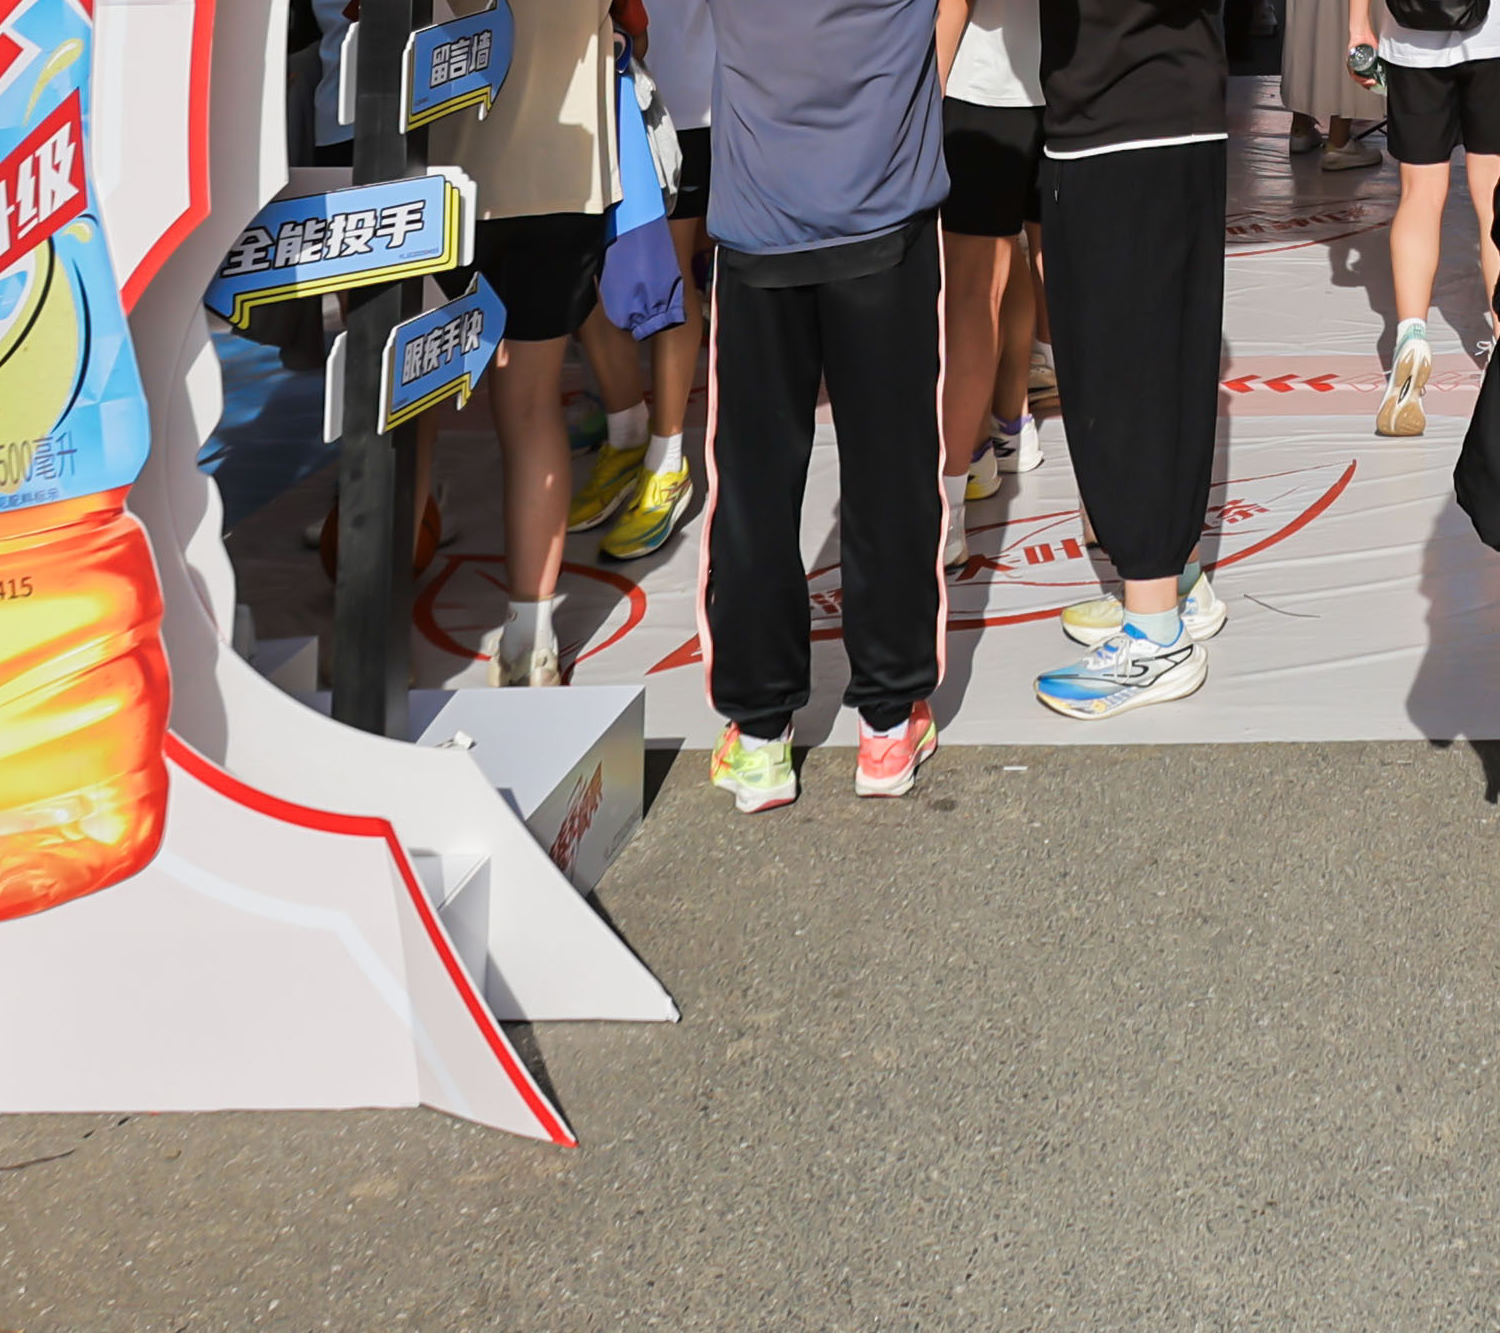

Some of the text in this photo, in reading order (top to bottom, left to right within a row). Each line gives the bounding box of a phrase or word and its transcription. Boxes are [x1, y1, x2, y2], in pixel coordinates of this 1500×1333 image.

[430, 30, 492, 90] 留言墙
[219, 200, 426, 277] 全能投手
[403, 309, 485, 385] 眼疾手快
